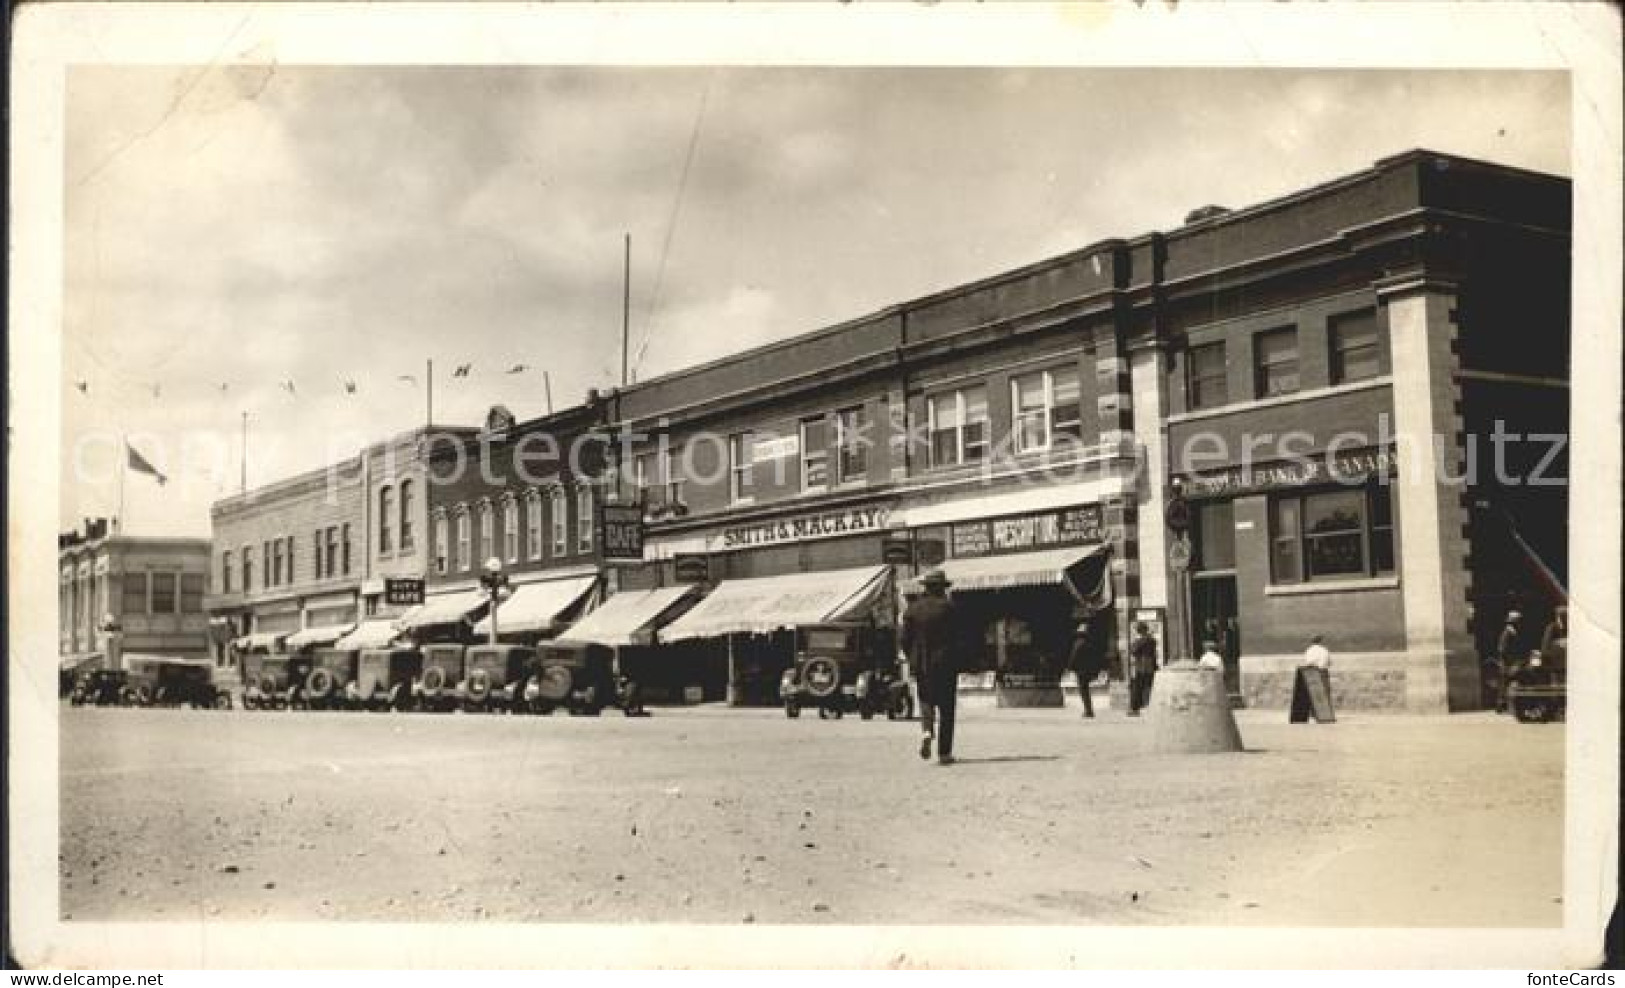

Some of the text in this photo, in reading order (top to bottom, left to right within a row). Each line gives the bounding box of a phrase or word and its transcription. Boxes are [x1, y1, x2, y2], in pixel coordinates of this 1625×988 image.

[606, 523, 639, 549] CAFE
[724, 509, 879, 546] SMITH & MACKAY
